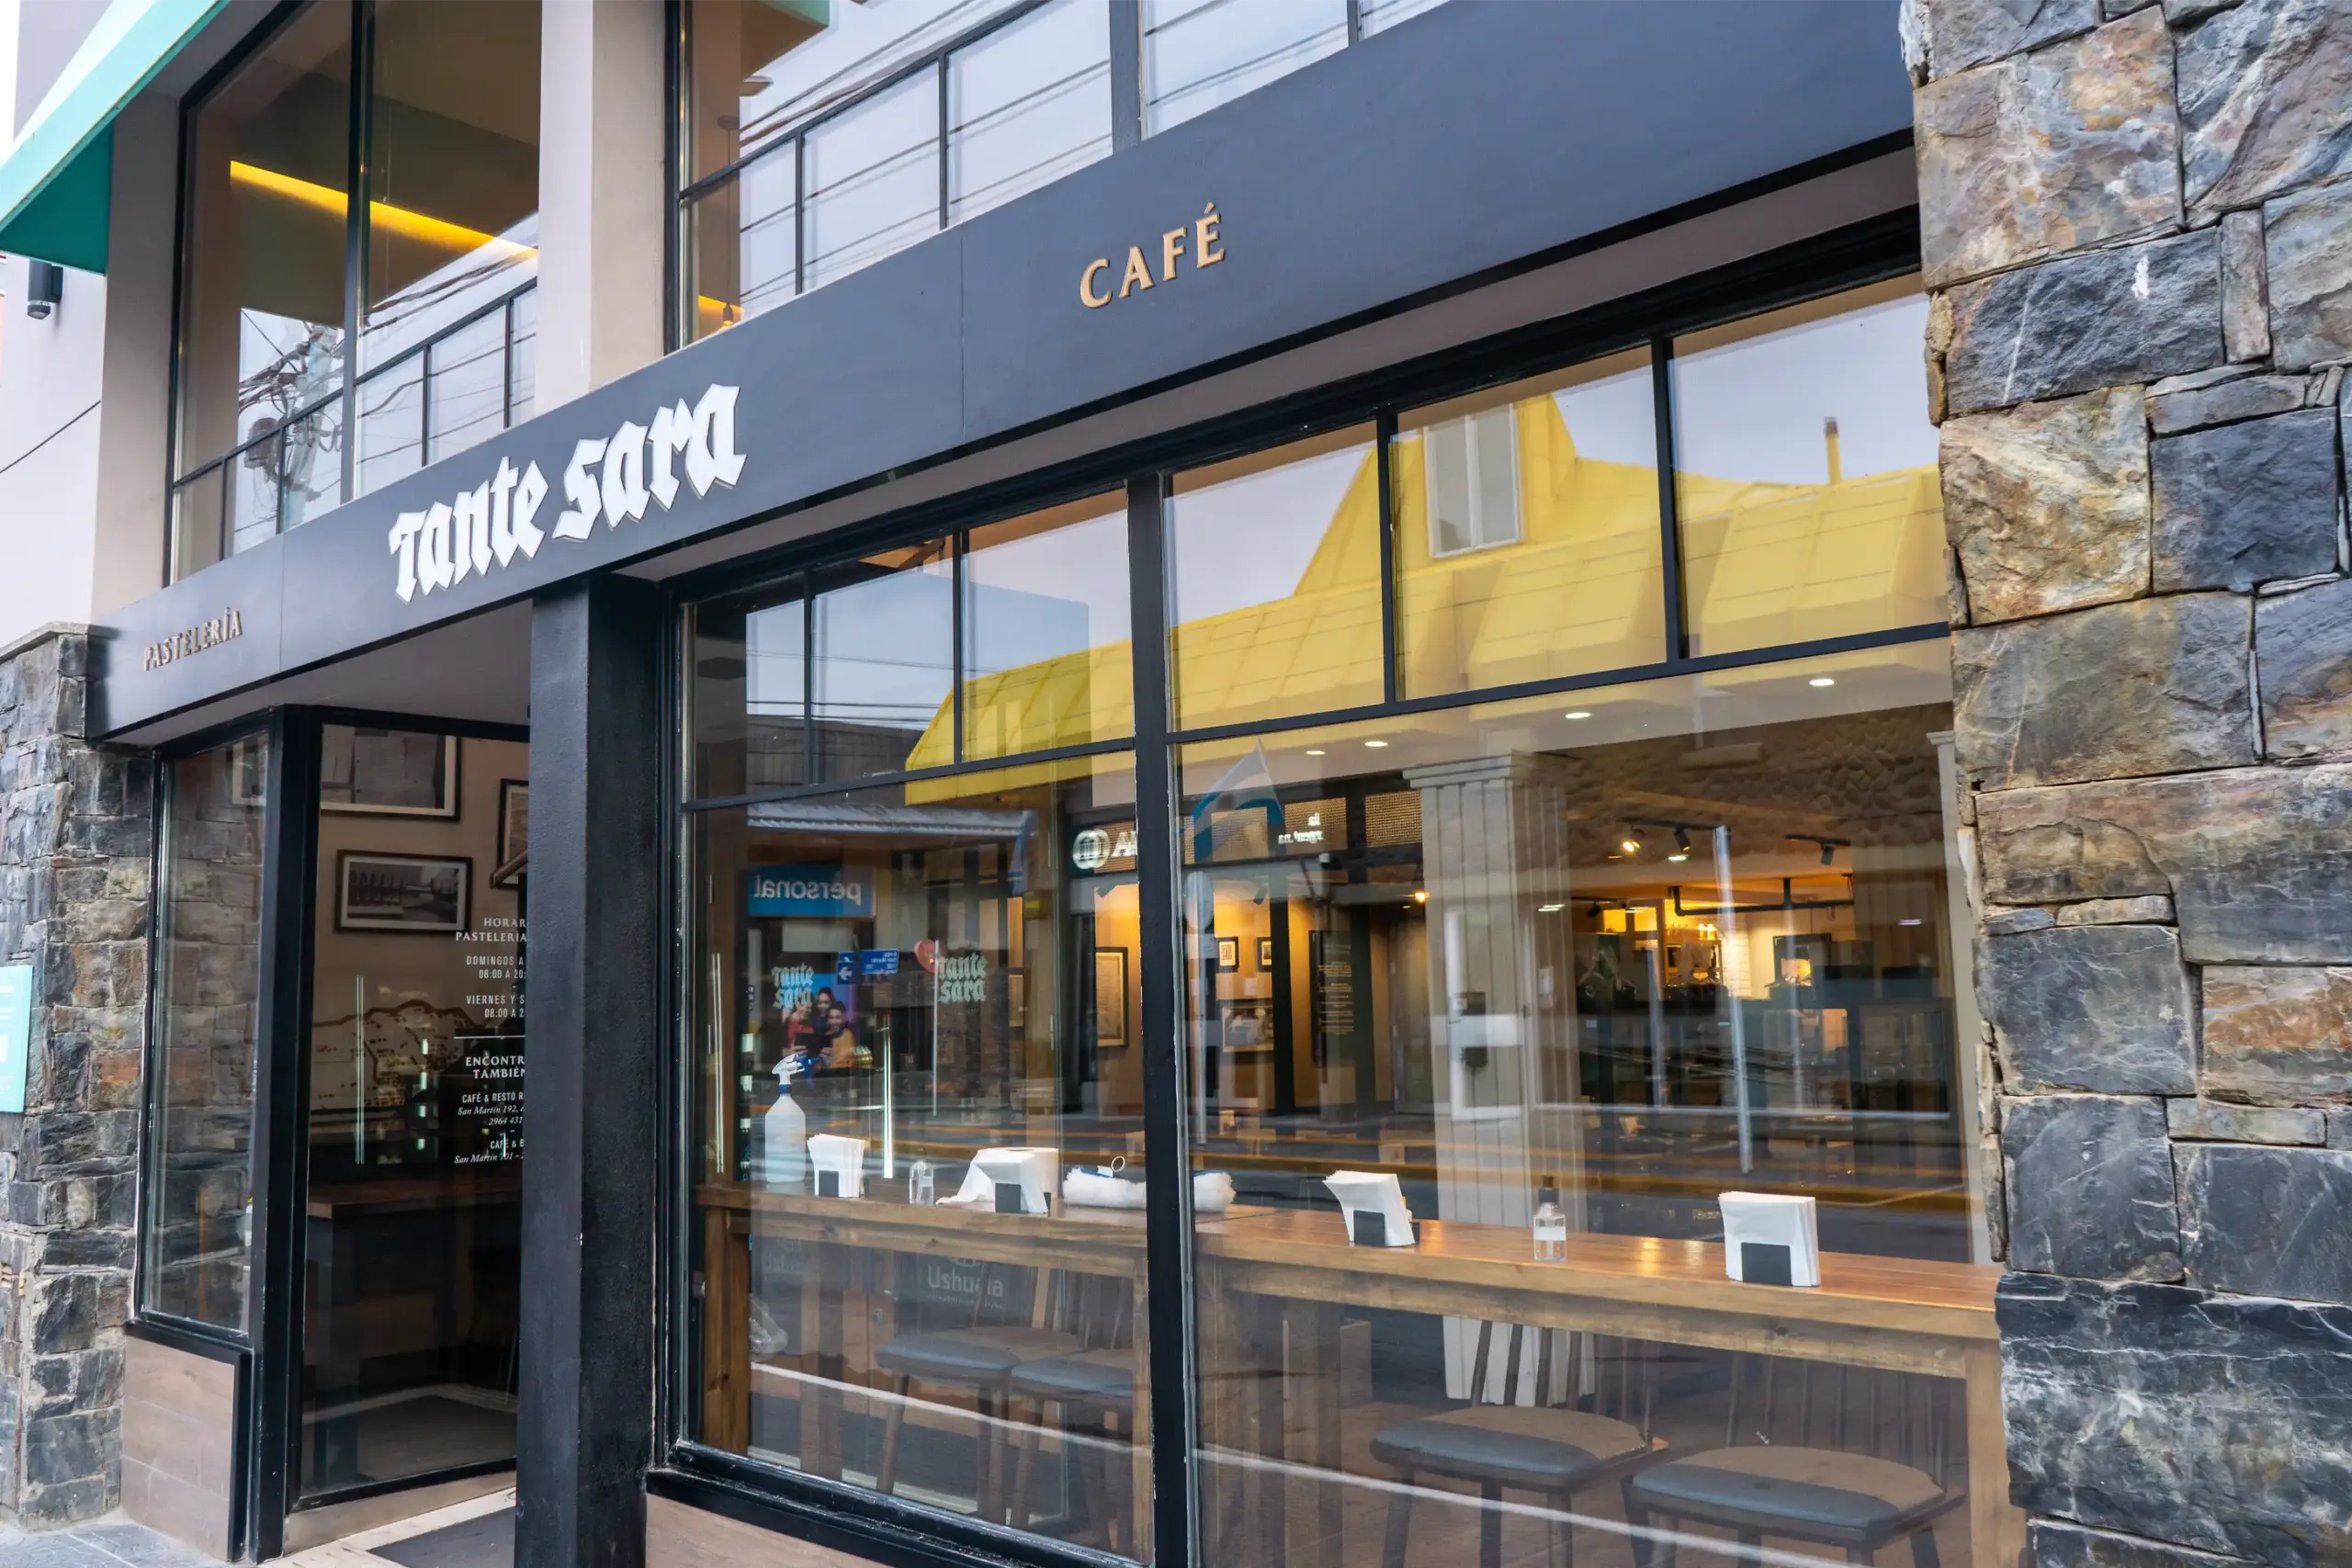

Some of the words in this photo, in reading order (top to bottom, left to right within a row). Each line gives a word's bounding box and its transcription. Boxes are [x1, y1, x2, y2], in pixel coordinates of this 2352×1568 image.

[1080, 201, 1226, 310] CAFÉ
[466, 955, 514, 965] DOMINGOS
[479, 969, 503, 979] 08:00
[504, 969, 511, 979] A
[466, 995, 505, 1005] VIERNES
[510, 995, 515, 1005] Y
[484, 1008, 508, 1018] 08:00
[511, 1008, 516, 1018] A
[462, 1092, 481, 1103] CAFÉ
[458, 1106, 472, 1116] San
[454, 1155, 469, 1165] San
